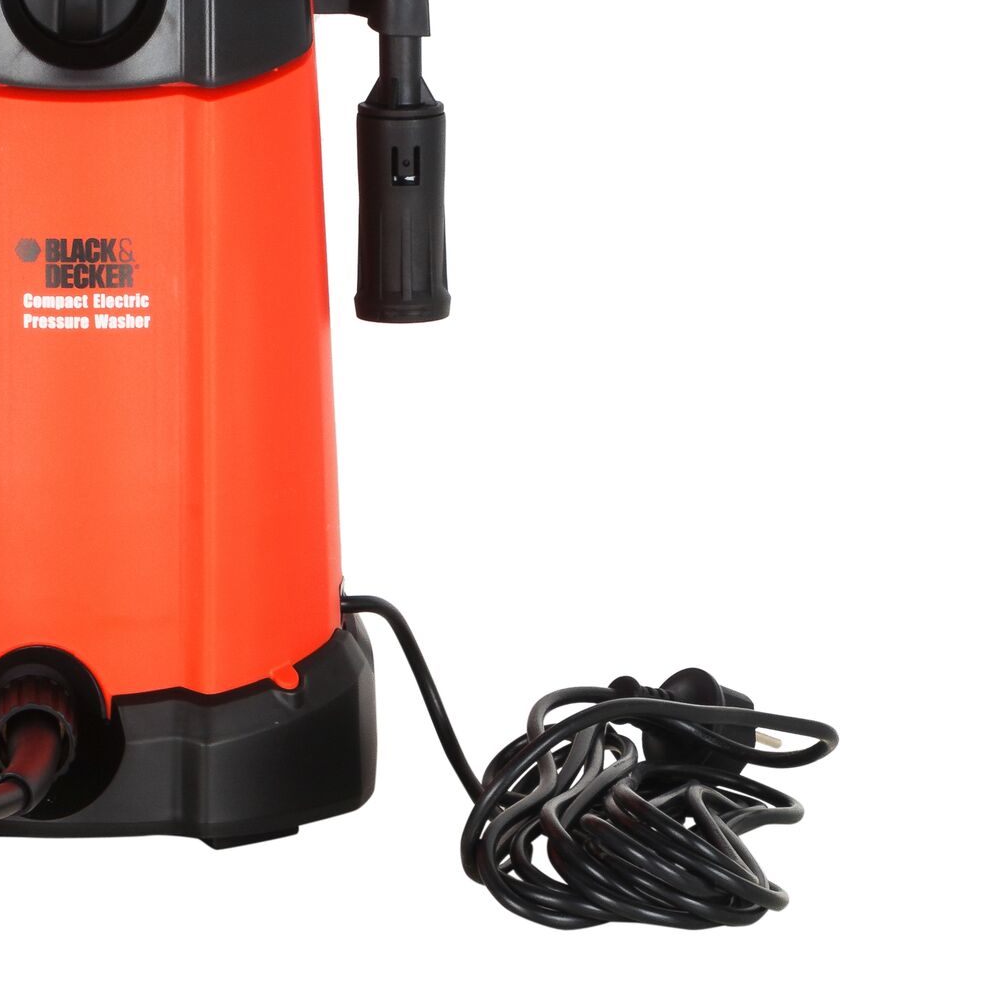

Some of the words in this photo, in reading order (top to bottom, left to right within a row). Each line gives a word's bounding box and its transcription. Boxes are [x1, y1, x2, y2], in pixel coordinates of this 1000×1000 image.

[45, 264, 134, 289] DECKER
[23, 292, 89, 310] Compact
[93, 292, 150, 309] Electric
[23, 313, 90, 329] Pressure
[94, 313, 151, 329] Washer
